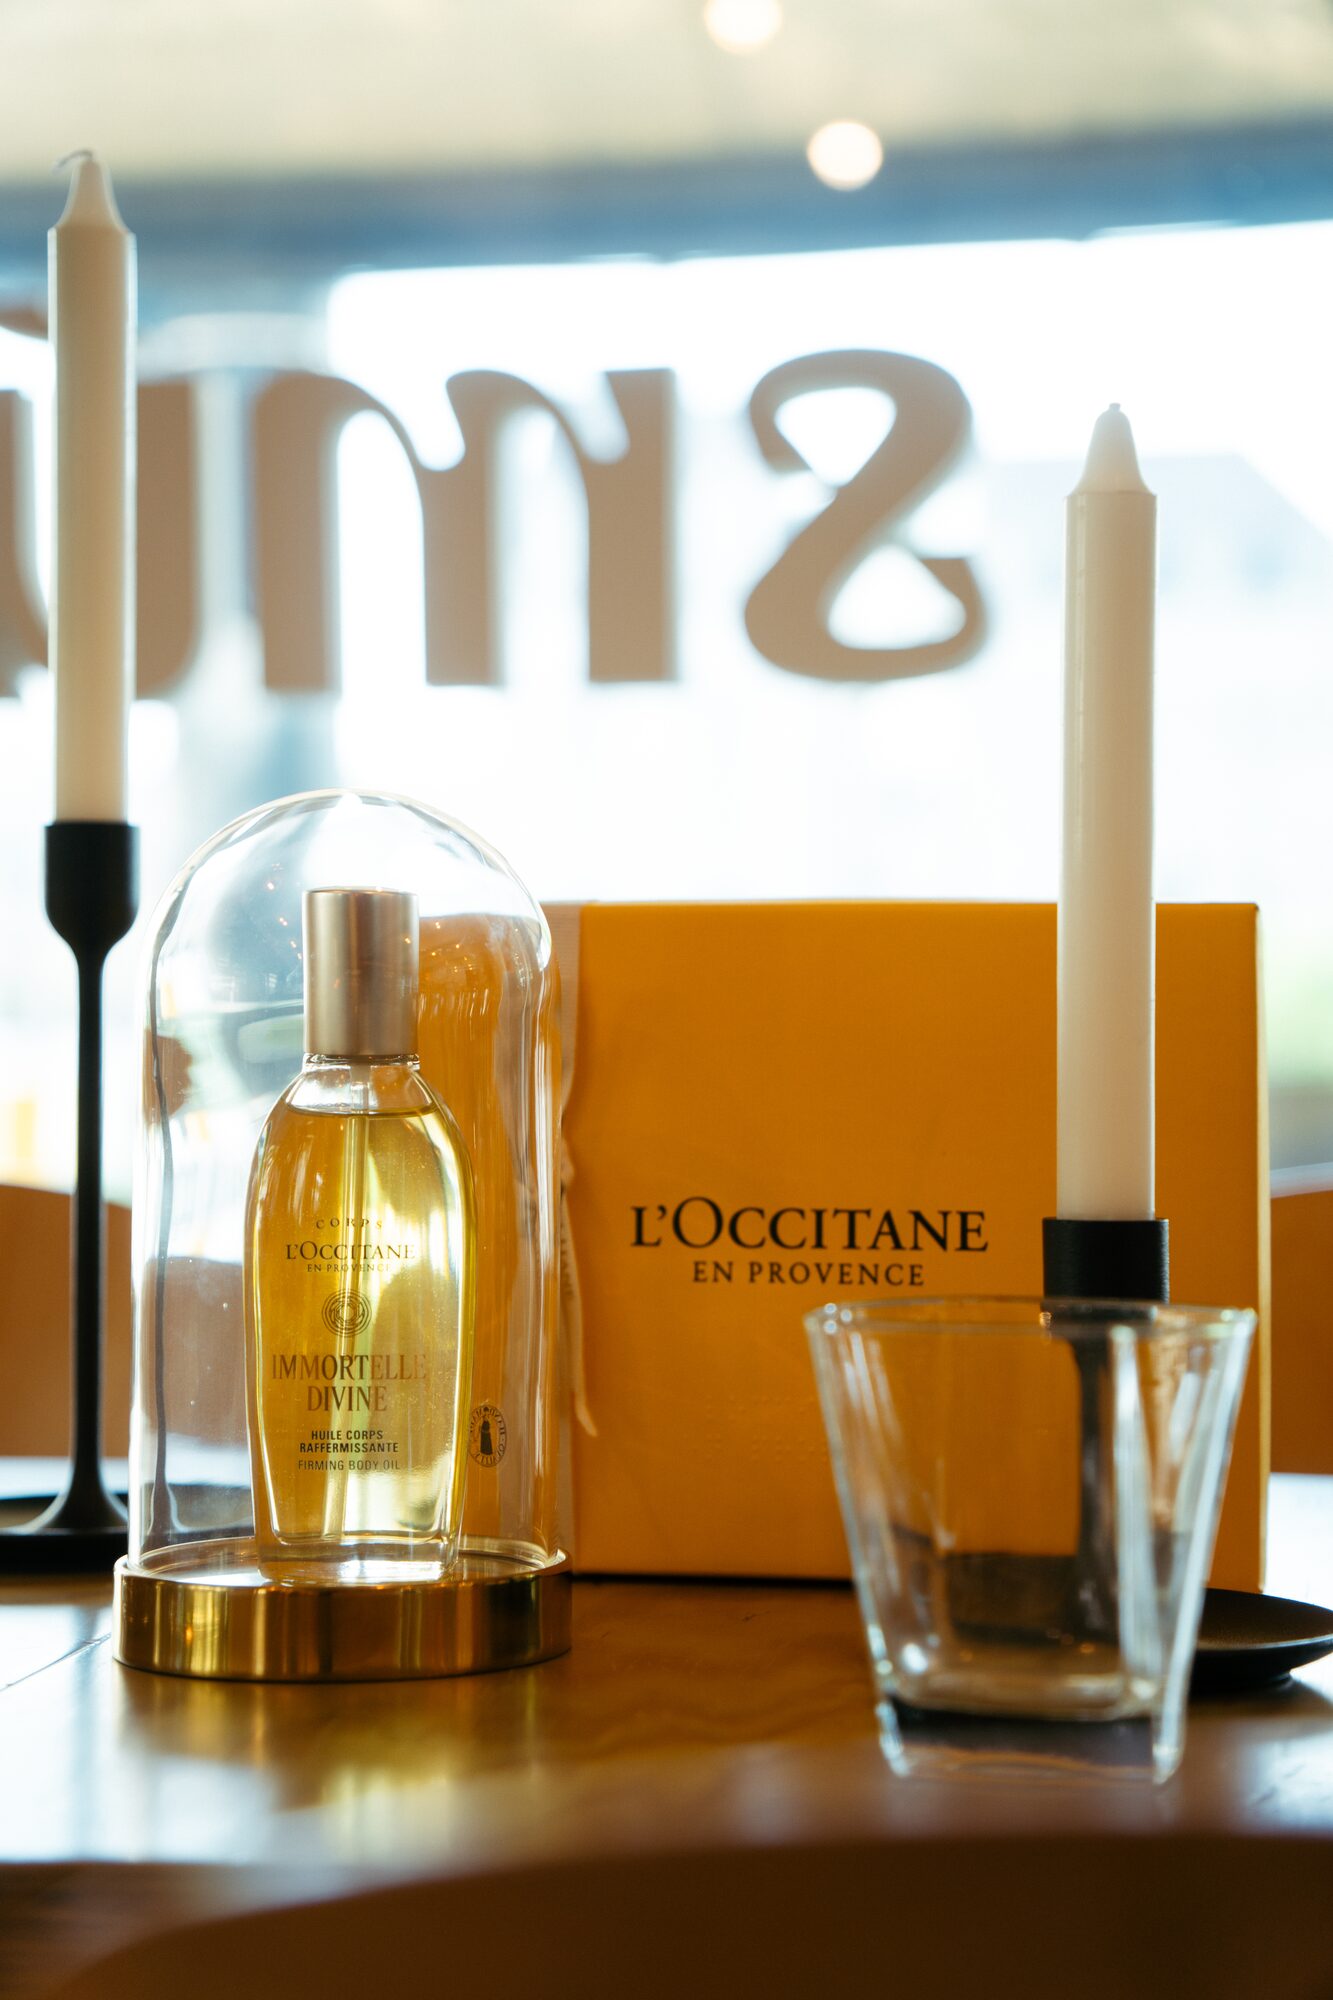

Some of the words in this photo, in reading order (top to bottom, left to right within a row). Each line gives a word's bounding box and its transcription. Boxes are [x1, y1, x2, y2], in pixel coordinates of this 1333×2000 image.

[316, 1217, 382, 1229] CORPS
[630, 1196, 989, 1252] L'OCCITANE
[286, 1241, 415, 1260] L'OCCITANE
[307, 1264, 322, 1272] EN
[692, 1260, 734, 1283] EN
[748, 1261, 924, 1286] PROVENCE
[272, 1354, 427, 1381] IMMORTELLE
[307, 1386, 388, 1412] DIVINE
[311, 1430, 342, 1440] HUILE
[346, 1430, 384, 1440] CORPS
[300, 1443, 399, 1453] RAFFERMISSANTE
[298, 1460, 344, 1471] FIRMING
[349, 1460, 379, 1471] BODY
[383, 1460, 401, 1471] OIL
